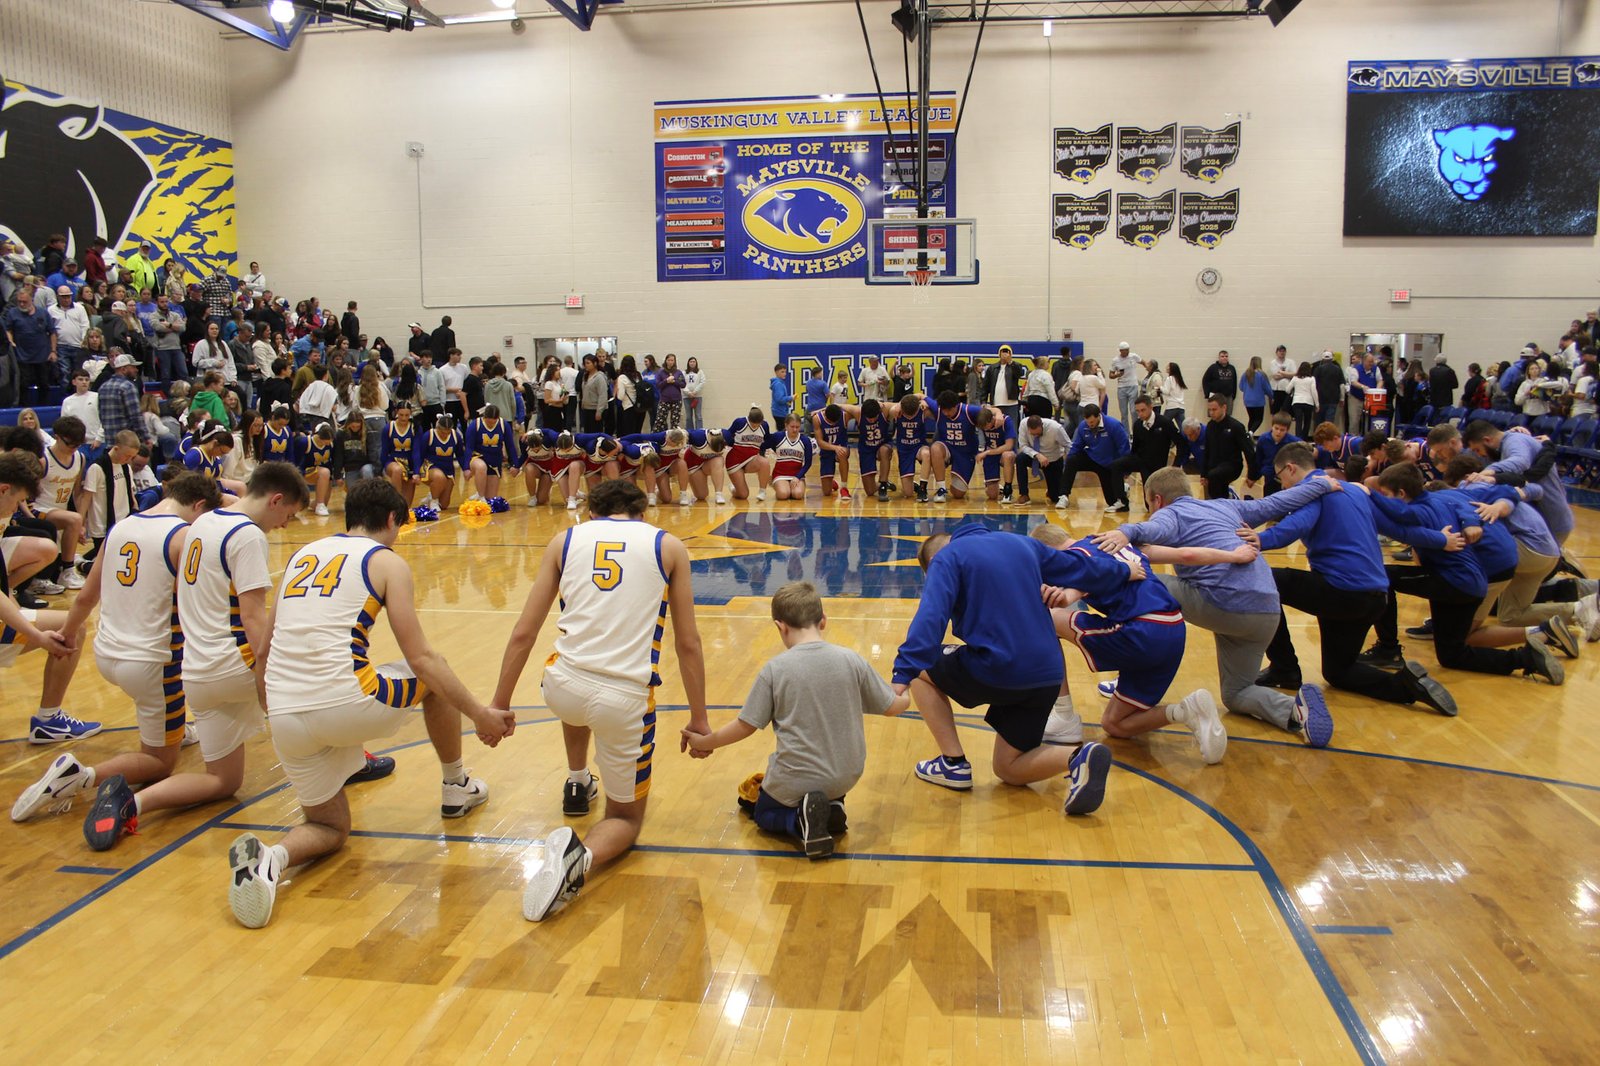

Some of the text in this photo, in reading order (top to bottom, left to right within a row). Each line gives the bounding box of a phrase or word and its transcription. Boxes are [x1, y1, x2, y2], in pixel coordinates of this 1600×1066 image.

[1384, 67, 1571, 88] MAYSVILLE
[660, 107, 951, 129] MUSKINGUM VALLEY LEAGUE
[737, 141, 869, 157] HOME OF THE
[736, 159, 871, 197] MAYSVILLE
[890, 168, 919, 176] MORGA
[892, 190, 919, 200] PHIL
[889, 236, 929, 244] SHERID
[742, 242, 866, 274] PANTHERS
[1394, 290, 1408, 300] EXIT
[824, 426, 840, 434] WEST
[866, 428, 882, 440] 33
[905, 429, 914, 438] 5
[946, 430, 963, 440] 55
[985, 431, 1000, 439] WEST
[271, 439, 287, 454] M
[393, 438, 411, 452] M
[482, 433, 500, 447] M
[990, 439, 997, 448] 3
[313, 449, 331, 465] M
[435, 446, 453, 457] M
[56, 487, 71, 503] 12
[116, 541, 141, 587] 3
[184, 537, 203, 585] 0
[591, 541, 627, 592] 5
[283, 553, 349, 599] 24
